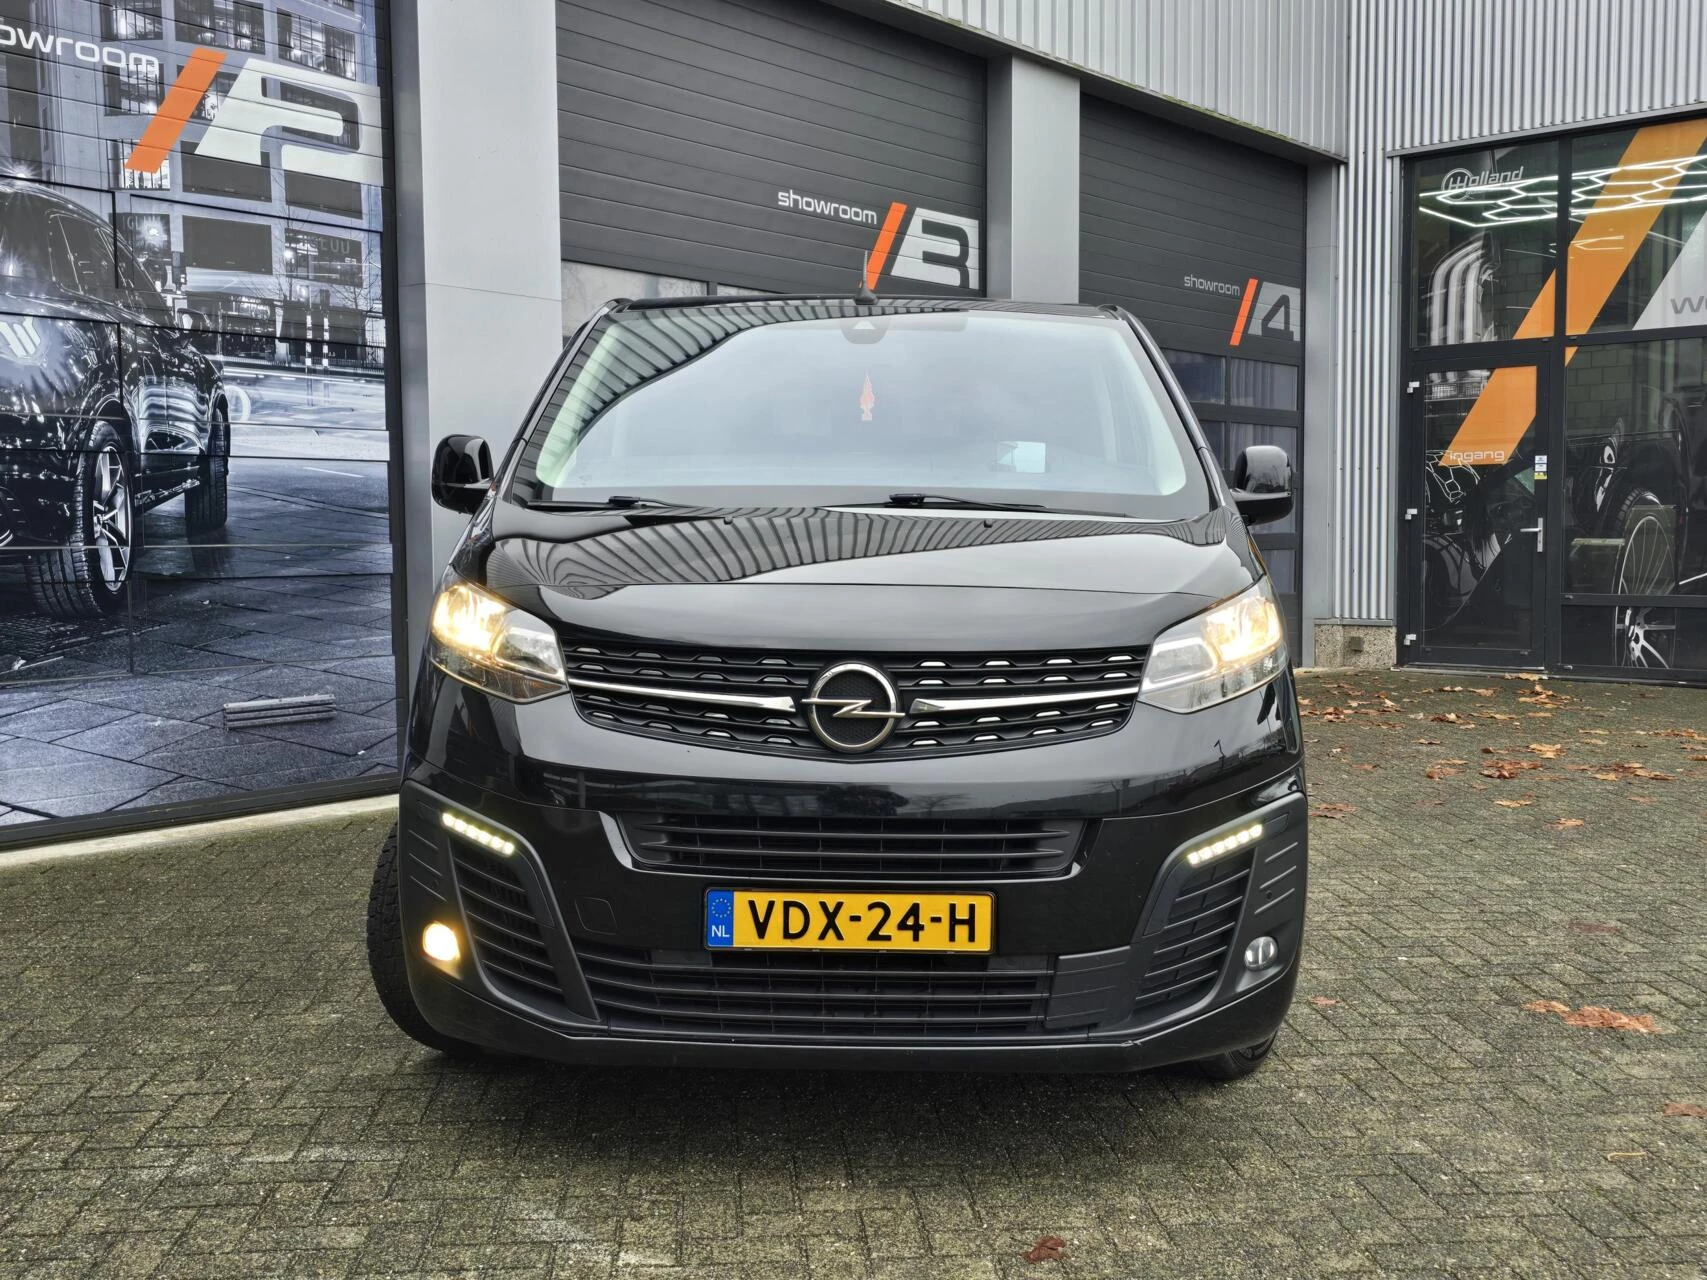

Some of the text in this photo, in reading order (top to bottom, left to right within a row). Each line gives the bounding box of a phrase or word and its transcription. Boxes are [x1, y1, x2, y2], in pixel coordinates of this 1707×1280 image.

[778, 190, 877, 225] showroom
[1184, 274, 1240, 296] showroom
[1450, 450, 1504, 463] ingang
[711, 924, 730, 938] NL
[748, 899, 976, 943] VDX-24-H
